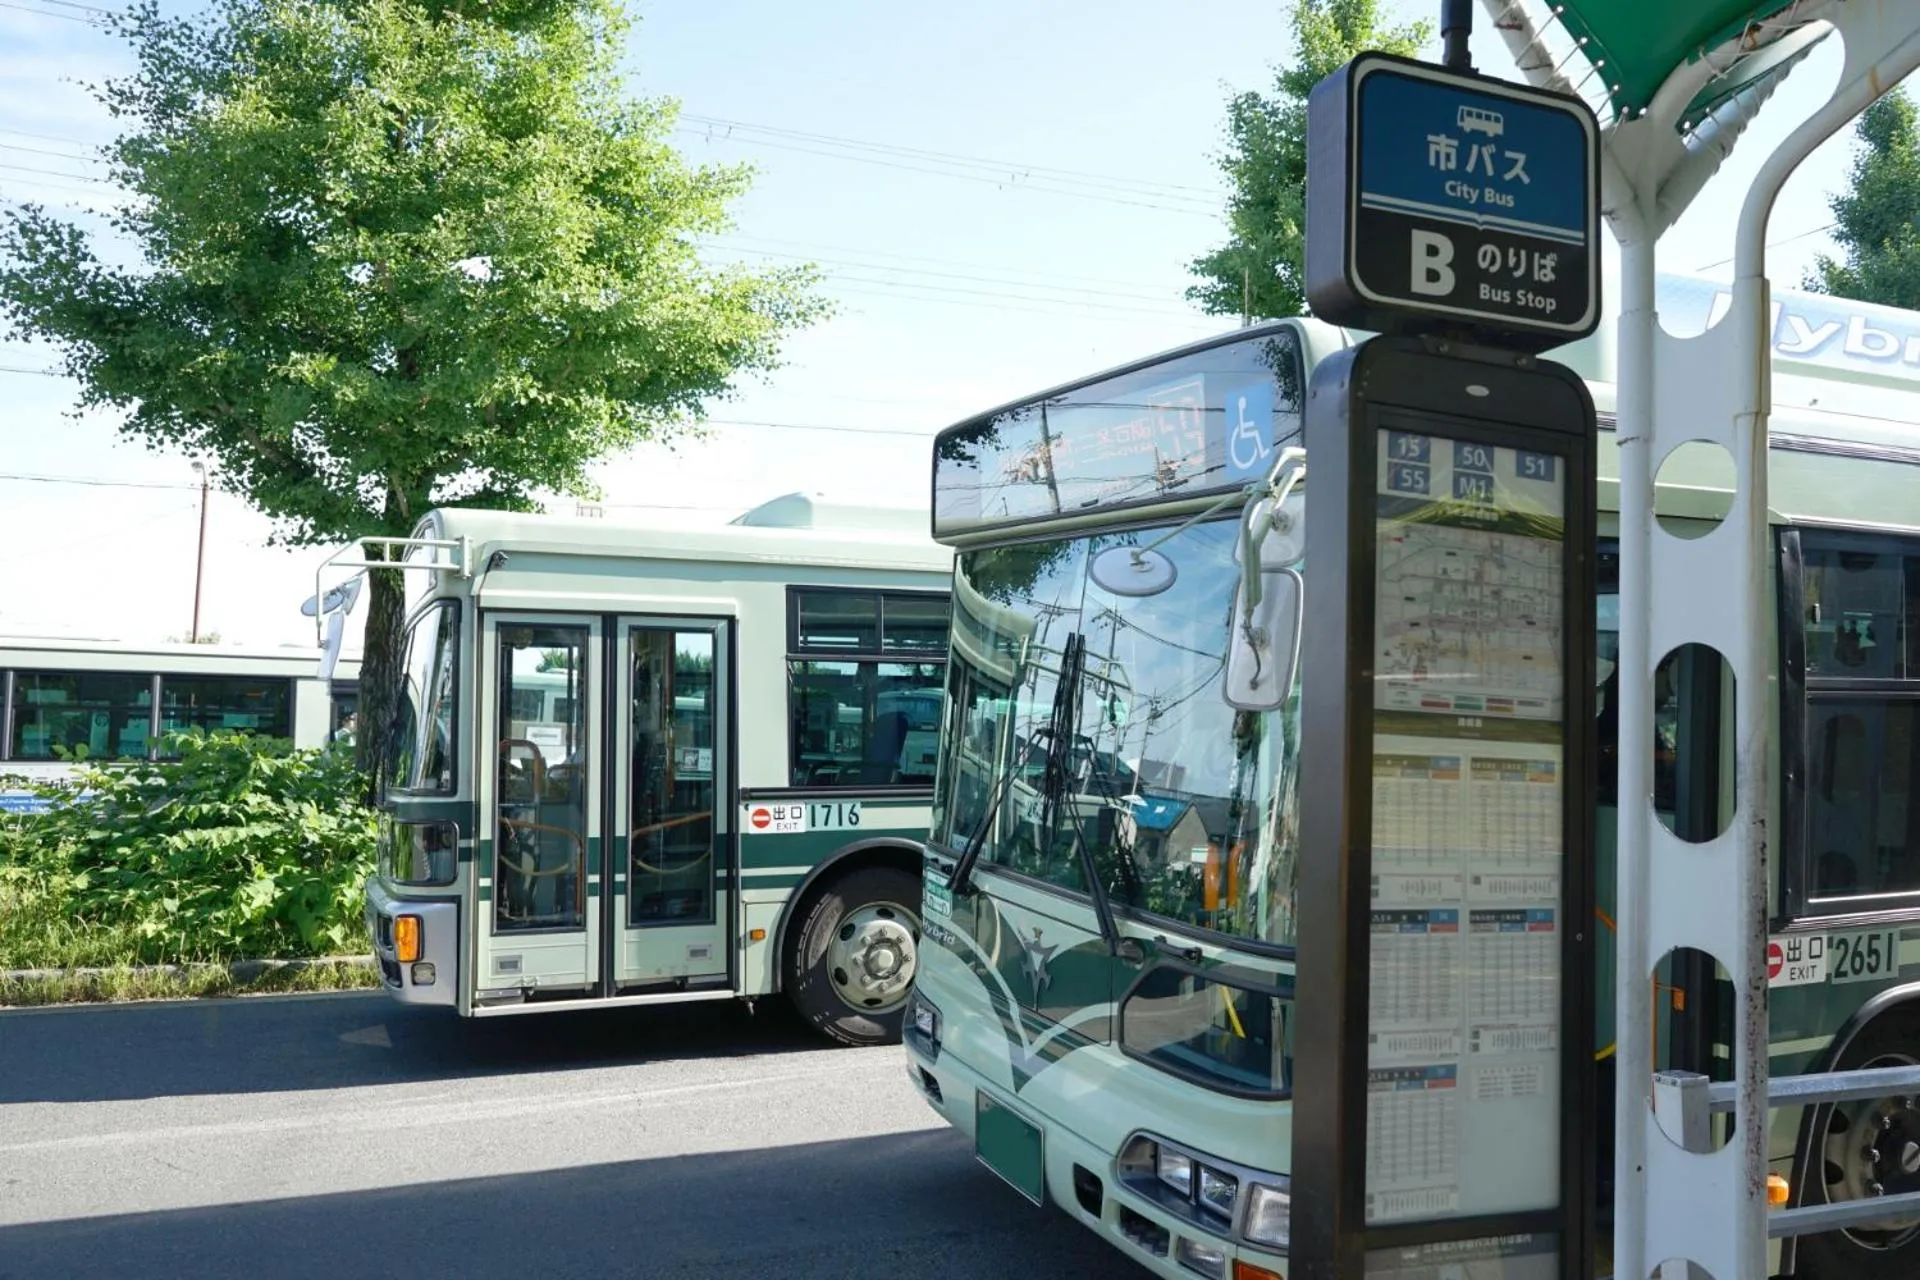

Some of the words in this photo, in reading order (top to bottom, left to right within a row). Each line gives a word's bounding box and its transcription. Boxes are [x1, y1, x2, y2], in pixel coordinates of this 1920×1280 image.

[1427, 133, 1530, 184] 市バス
[1445, 180, 1479, 205] City
[1484, 186, 1515, 207] Bus
[1410, 229, 1456, 297] B
[1477, 243, 1558, 283] のりば
[1479, 283, 1511, 303] Bus
[1516, 289, 1557, 313] Stop
[1397, 438, 1421, 458] 15
[1462, 448, 1485, 467] 50
[1524, 456, 1546, 477] 51
[1401, 470, 1425, 489] 55
[1459, 476, 1487, 498] M1
[772, 805, 802, 820] 出口
[776, 822, 798, 831] EXIT
[810, 803, 860, 828] 1716
[1786, 936, 1823, 963] 出口
[1833, 932, 1893, 979] 2651
[1789, 965, 1818, 981] EXIT
